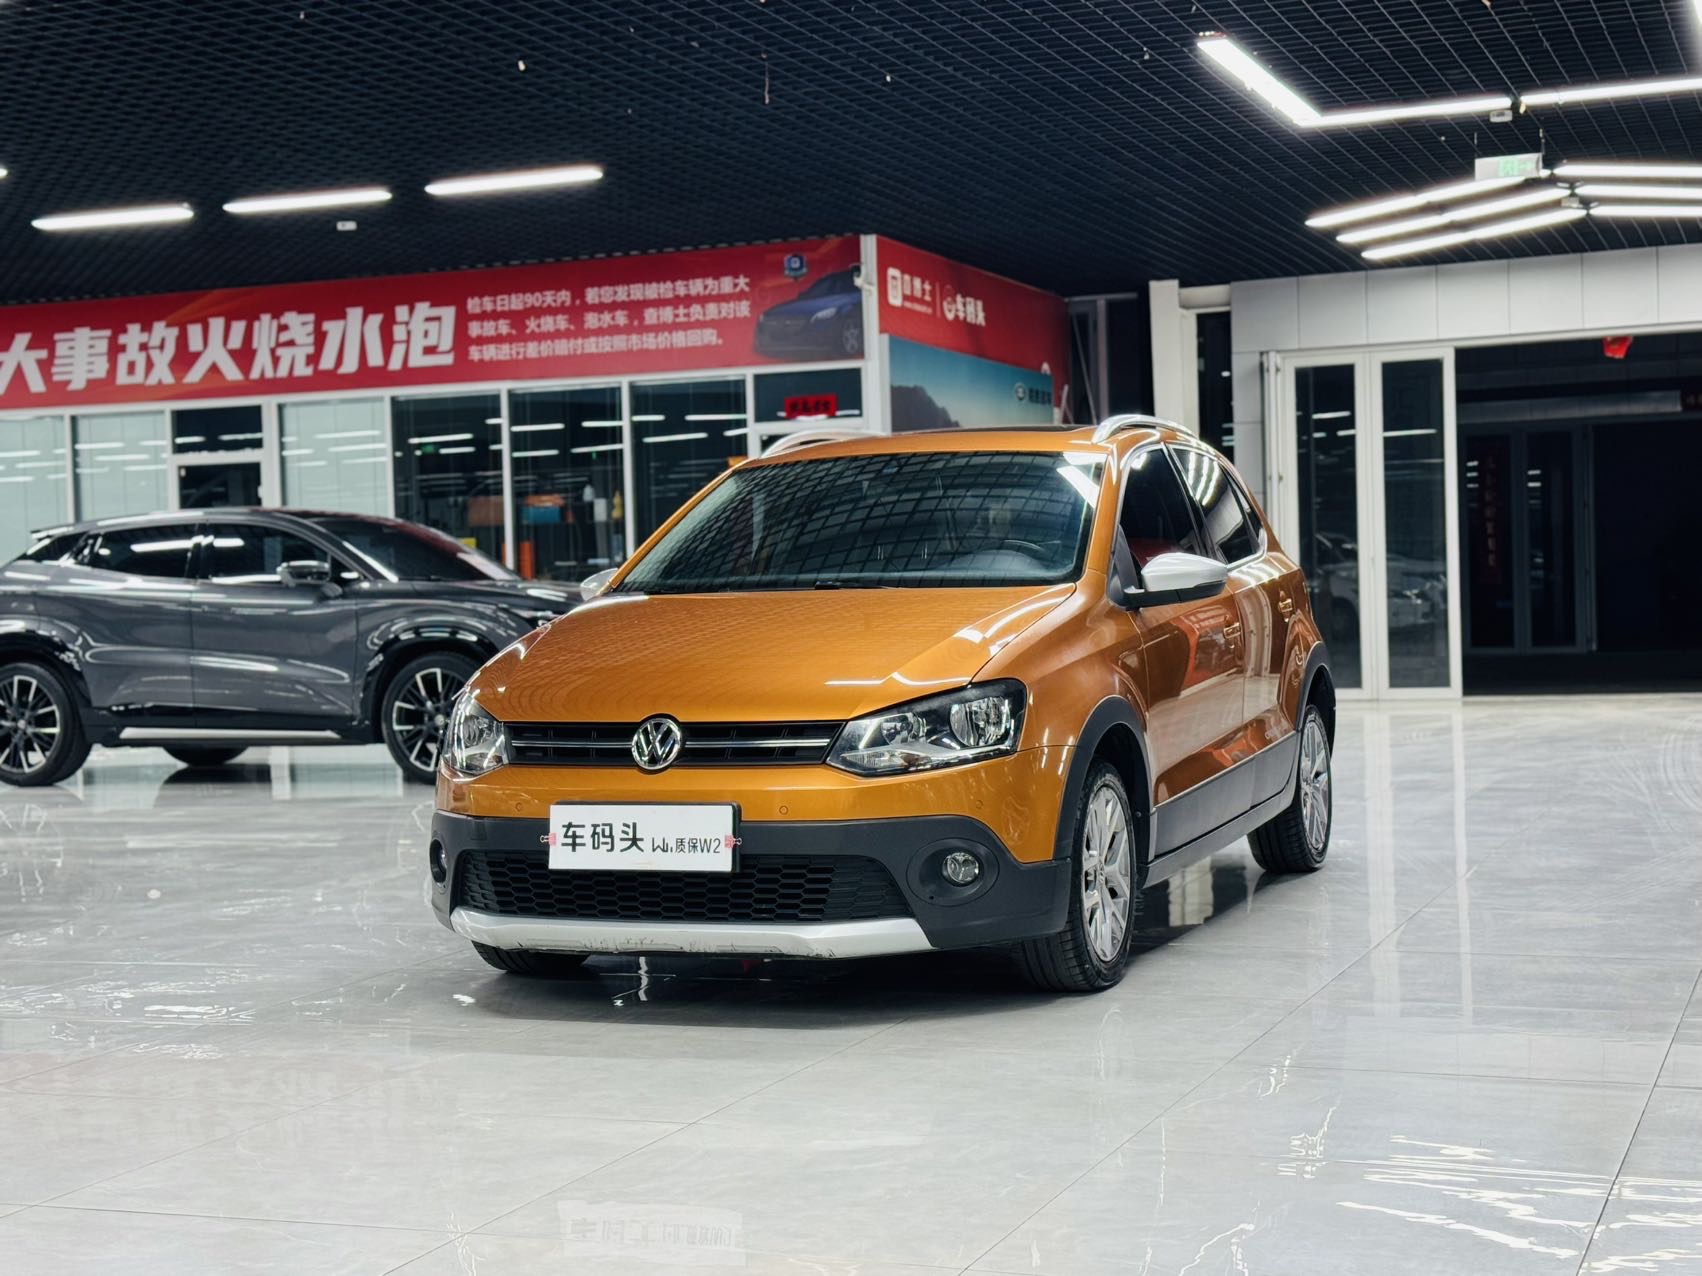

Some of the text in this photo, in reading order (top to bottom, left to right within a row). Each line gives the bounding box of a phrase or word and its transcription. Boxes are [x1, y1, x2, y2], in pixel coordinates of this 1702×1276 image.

[0, 302, 457, 395] 大事故火烧水泡
[561, 821, 645, 853] 车码头
[675, 837, 721, 854] 质保W2
